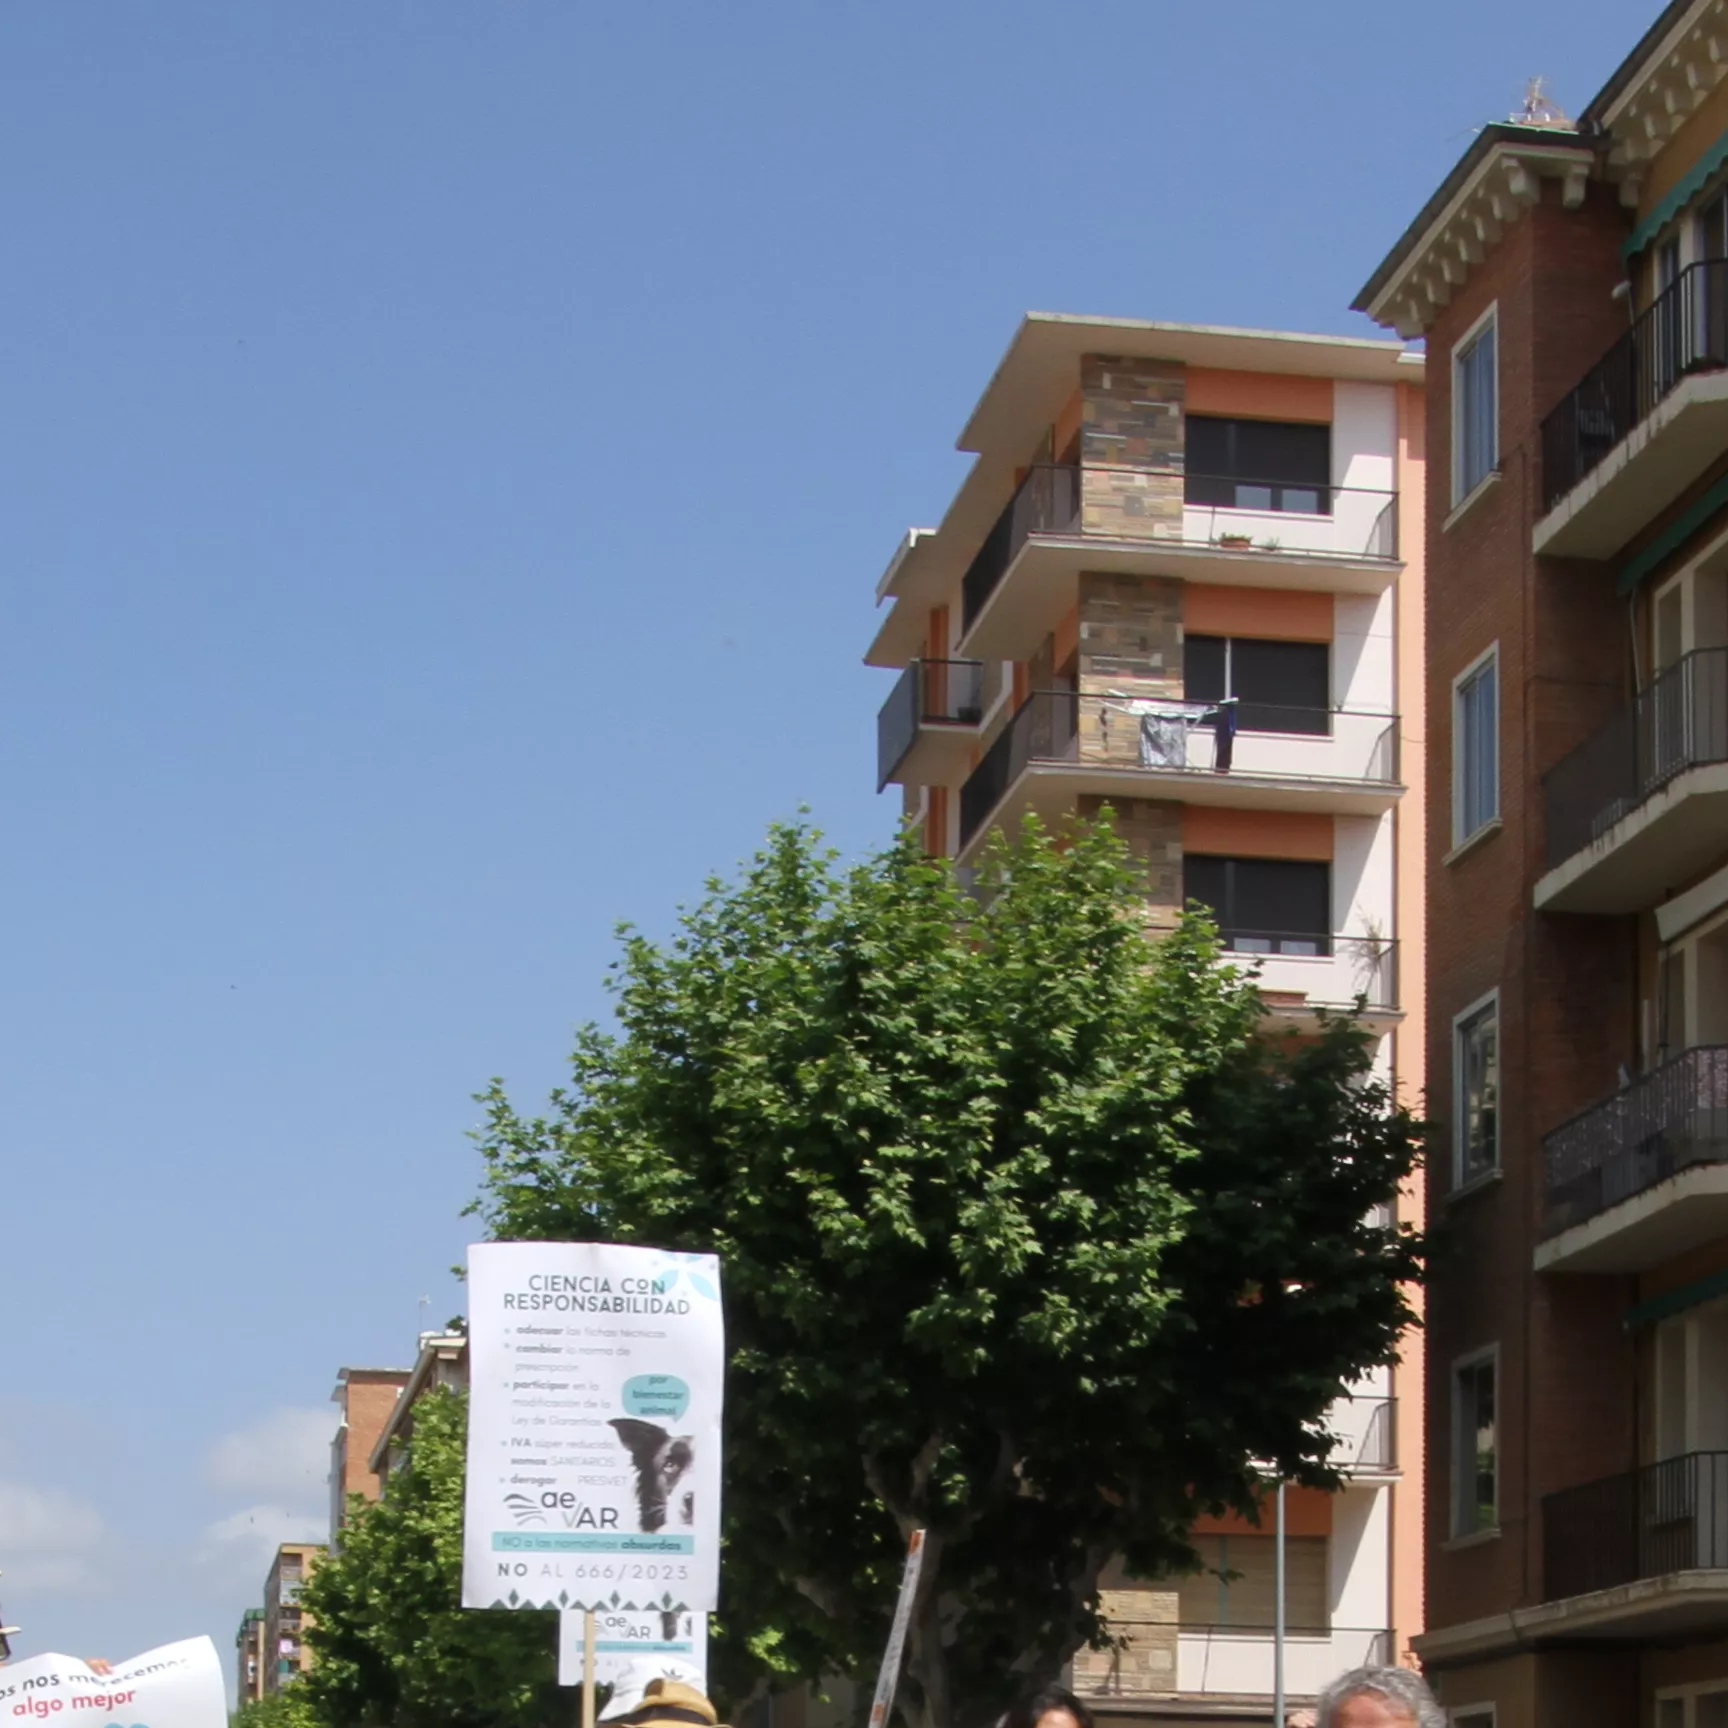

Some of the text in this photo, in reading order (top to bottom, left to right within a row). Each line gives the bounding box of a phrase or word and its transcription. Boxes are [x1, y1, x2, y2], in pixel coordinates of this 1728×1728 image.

[529, 1275, 611, 1293] CIENCIA
[504, 1293, 690, 1315] RESPONSABILIDAD
[513, 1380, 569, 1391] participar
[649, 1376, 668, 1387] por
[632, 1389, 684, 1400] bienestar
[511, 1437, 532, 1447] IVA
[550, 1455, 616, 1467] SANITARIOS
[510, 1473, 628, 1487] derogar PRESVET
[502, 1537, 522, 1548] NO
[535, 1538, 552, 1549] las
[554, 1538, 618, 1550] normativas
[621, 1538, 682, 1551] absurdas
[497, 1563, 689, 1581] NO AL 666/2023
[22, 1673, 61, 1691] nos
[12, 1688, 137, 1718] algo mejor
